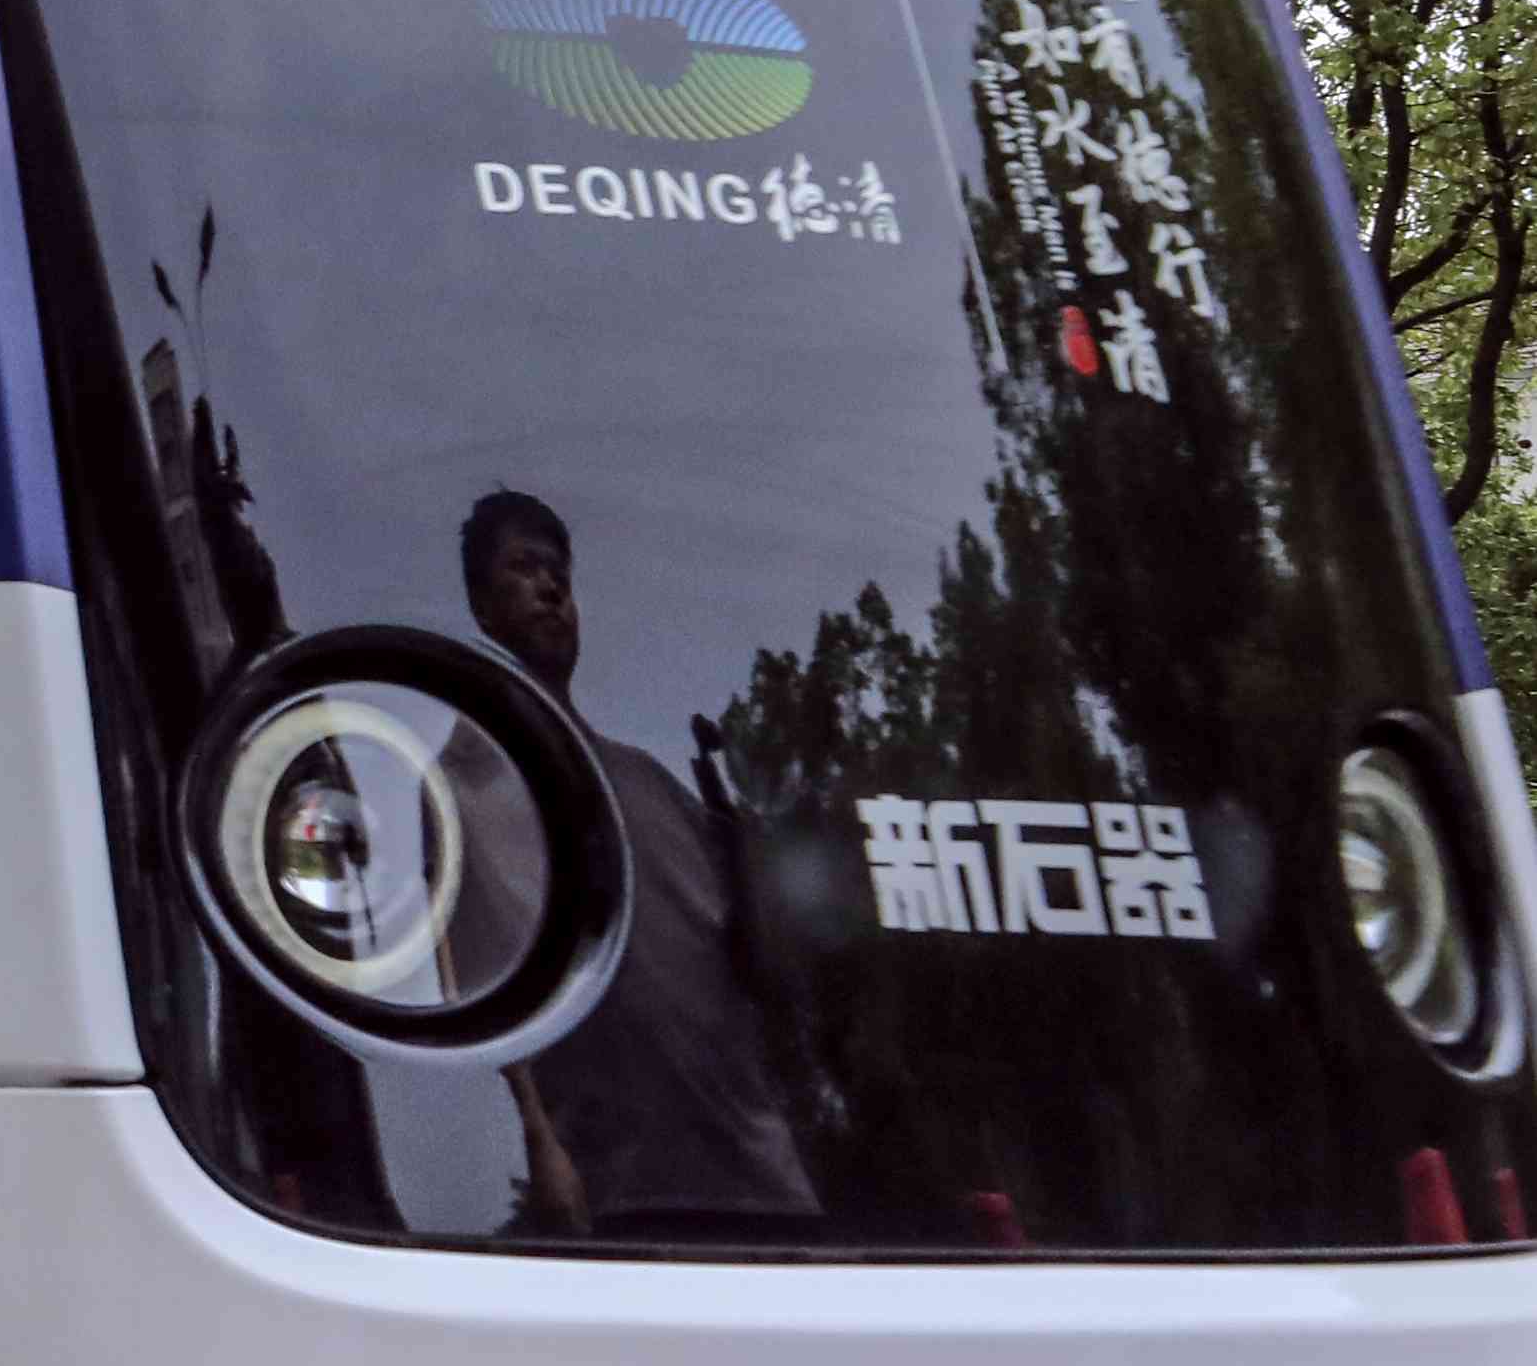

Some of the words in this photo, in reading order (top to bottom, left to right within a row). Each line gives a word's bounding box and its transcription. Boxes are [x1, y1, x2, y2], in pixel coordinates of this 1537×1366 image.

[474, 161, 758, 225] DEQING
[761, 152, 902, 244] 德清
[855, 792, 1216, 941] 新石器
